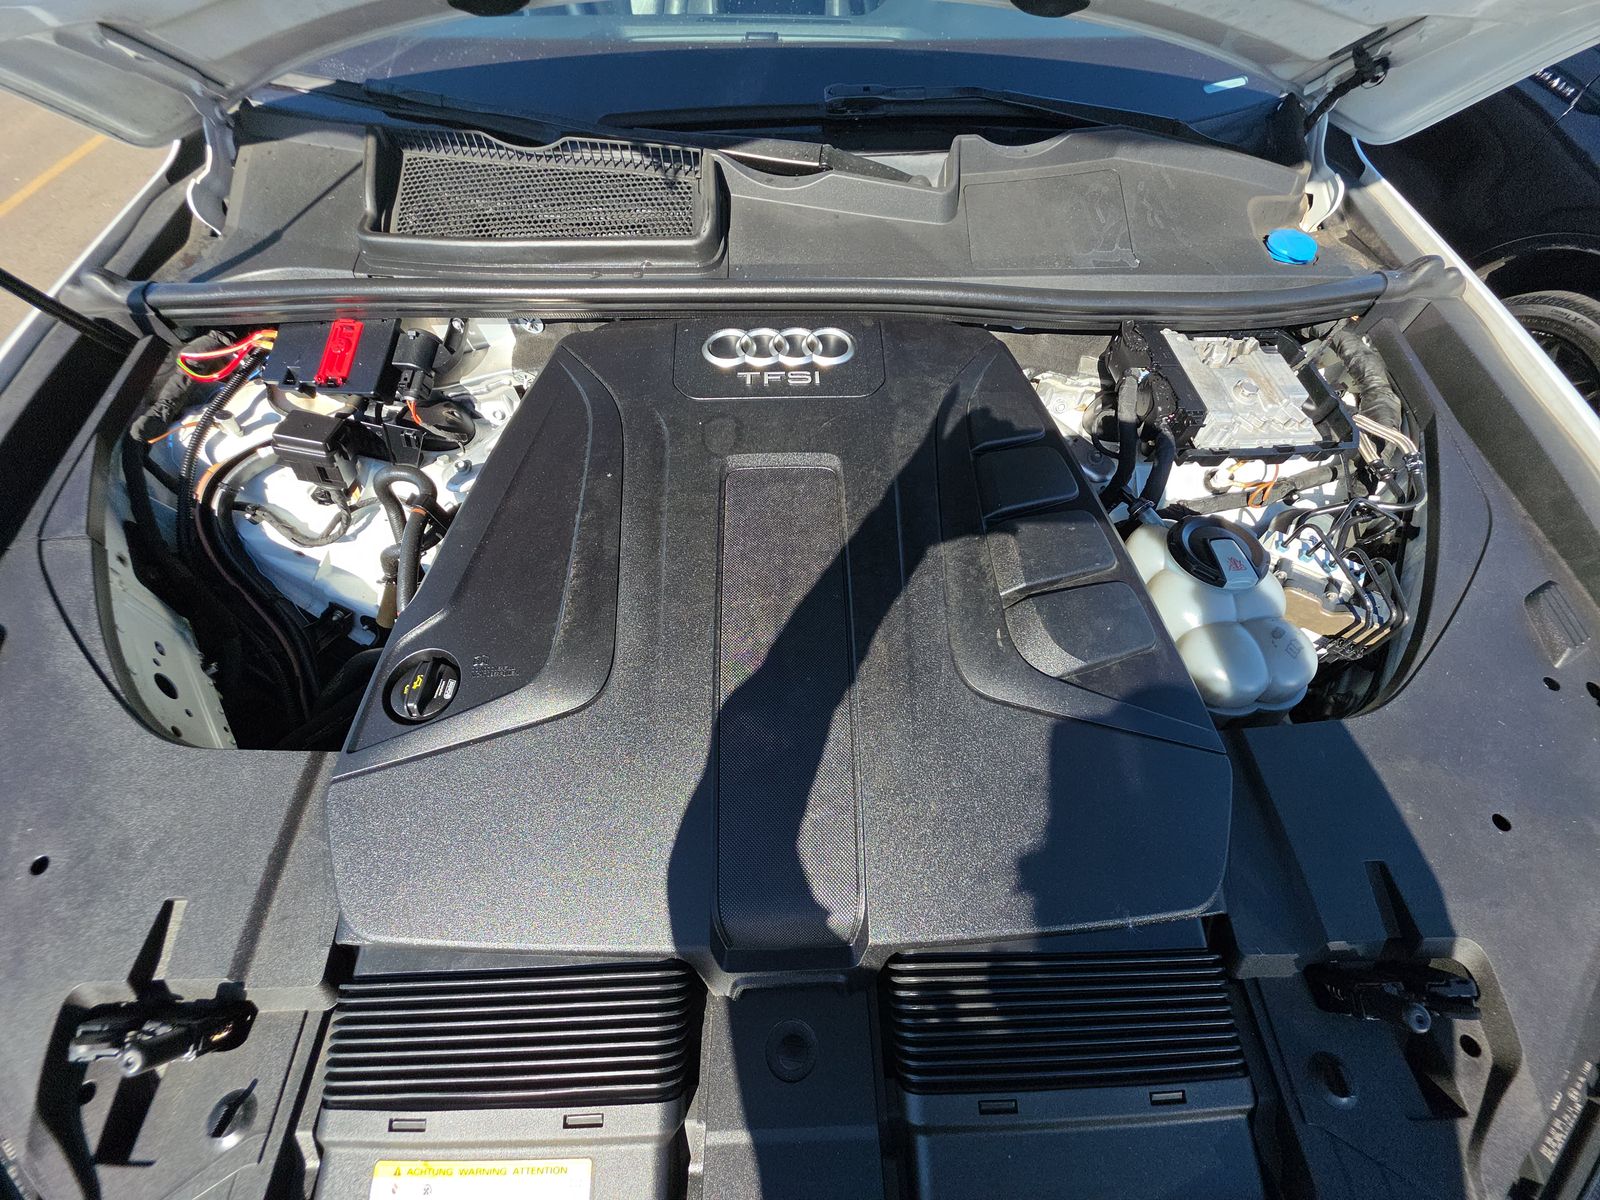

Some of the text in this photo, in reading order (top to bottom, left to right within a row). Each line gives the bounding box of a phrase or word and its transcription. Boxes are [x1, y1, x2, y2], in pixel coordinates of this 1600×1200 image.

[737, 371, 820, 385] TFSI
[407, 1166, 568, 1177] ACHTUNG WARNING ATTENTION
